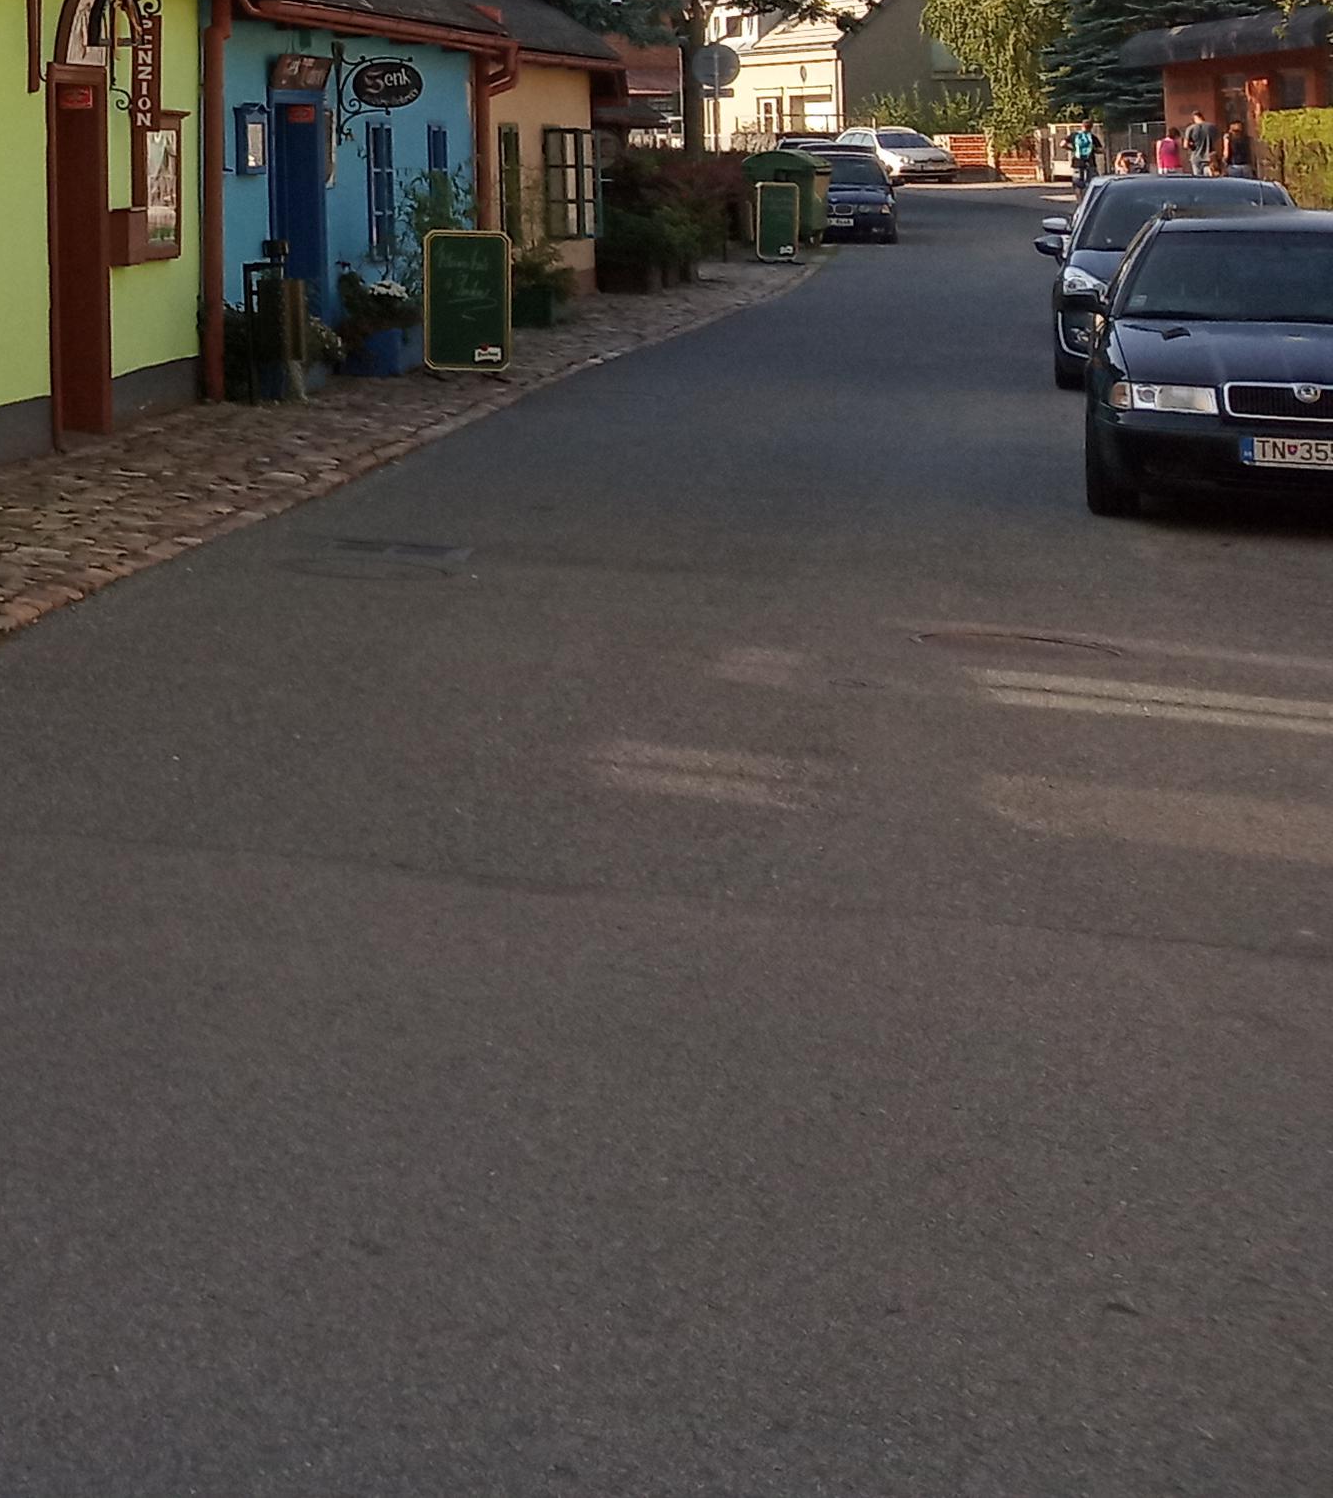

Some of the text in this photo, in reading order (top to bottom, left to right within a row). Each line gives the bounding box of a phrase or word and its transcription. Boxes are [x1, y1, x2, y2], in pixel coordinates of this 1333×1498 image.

[136, 19, 153, 127] PENZION
[1256, 439, 1333, 461] TN 35
